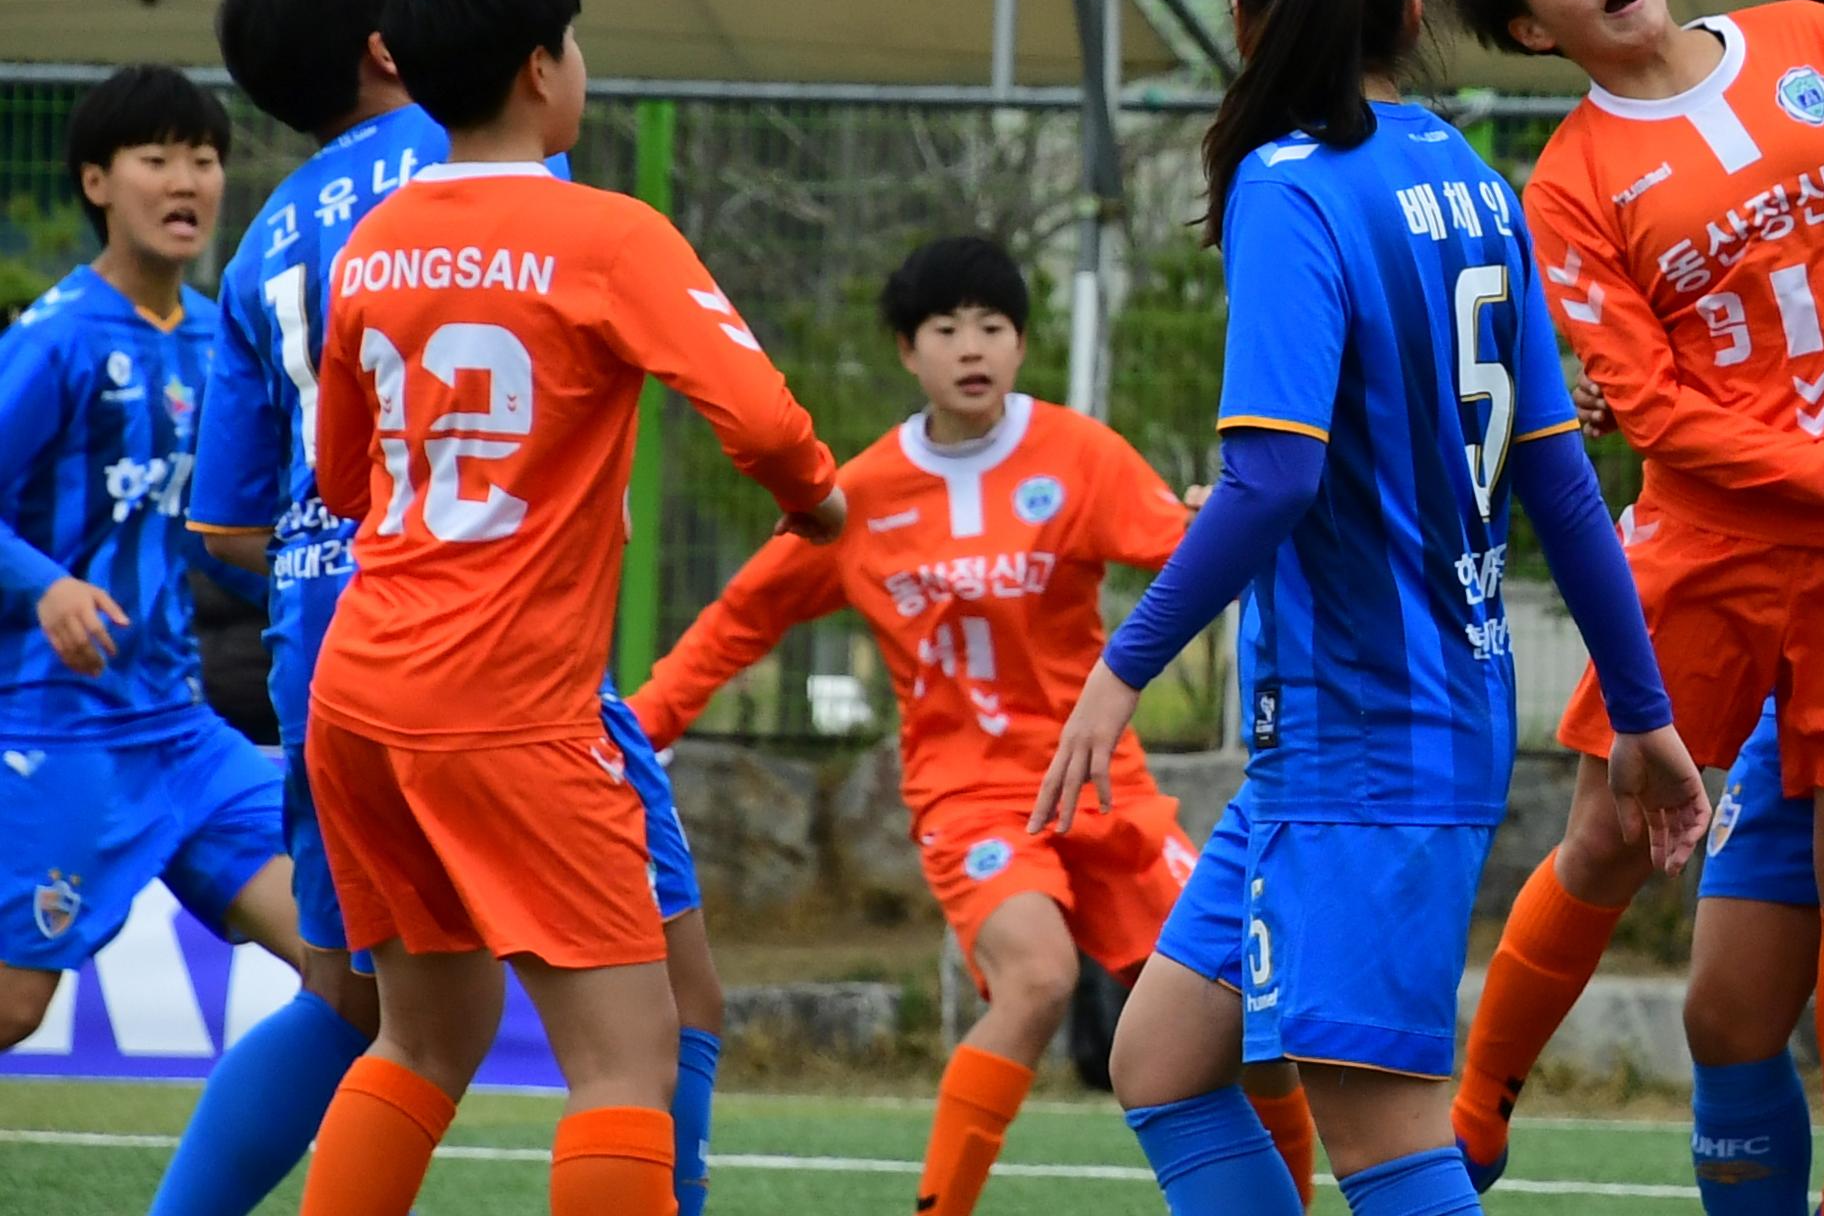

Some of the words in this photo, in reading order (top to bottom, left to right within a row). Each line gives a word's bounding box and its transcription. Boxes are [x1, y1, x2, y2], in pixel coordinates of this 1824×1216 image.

[264, 147, 419, 258] 고유나
[1396, 180, 1514, 242] 배채인
[340, 246, 555, 298] DONGSAN
[359, 321, 534, 542] 12
[1454, 264, 1516, 524] 5
[274, 538, 355, 591] 현대건
